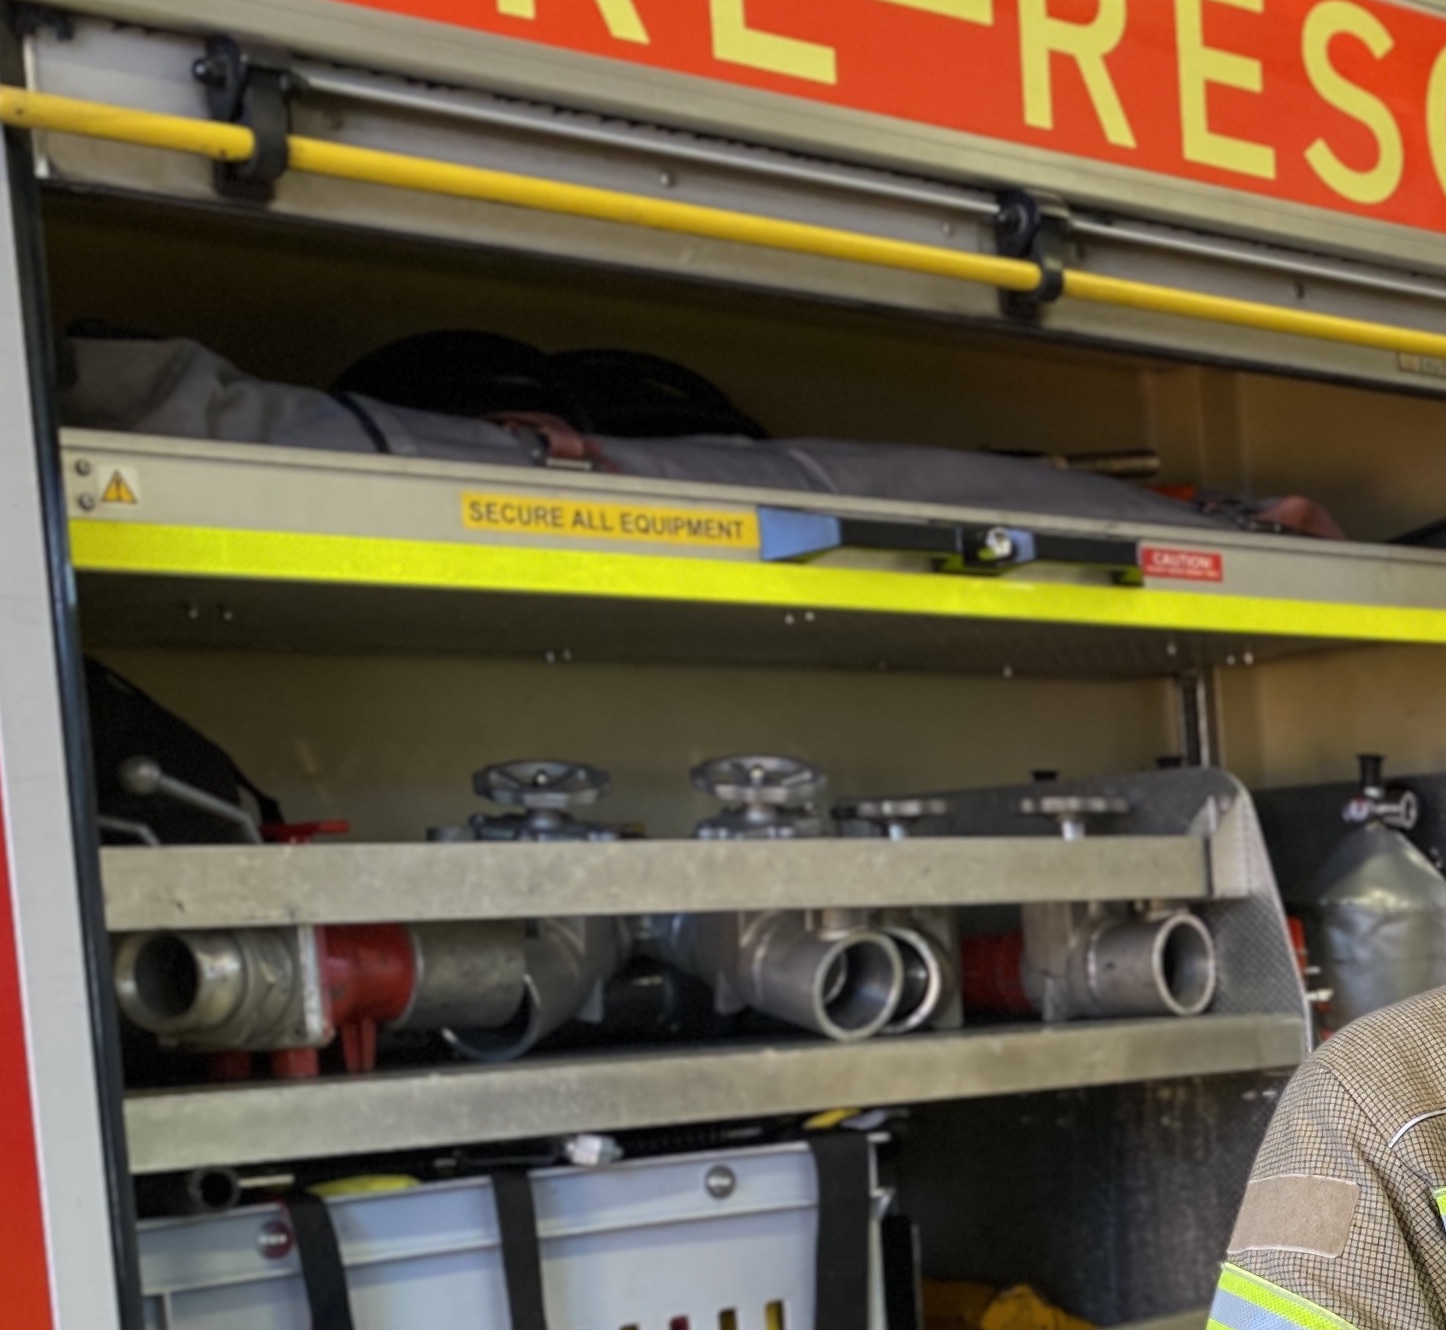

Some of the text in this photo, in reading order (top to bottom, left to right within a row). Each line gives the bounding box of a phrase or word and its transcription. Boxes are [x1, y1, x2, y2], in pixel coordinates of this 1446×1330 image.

[469, 501, 743, 540] SECURE ALL EQUIPMENT
